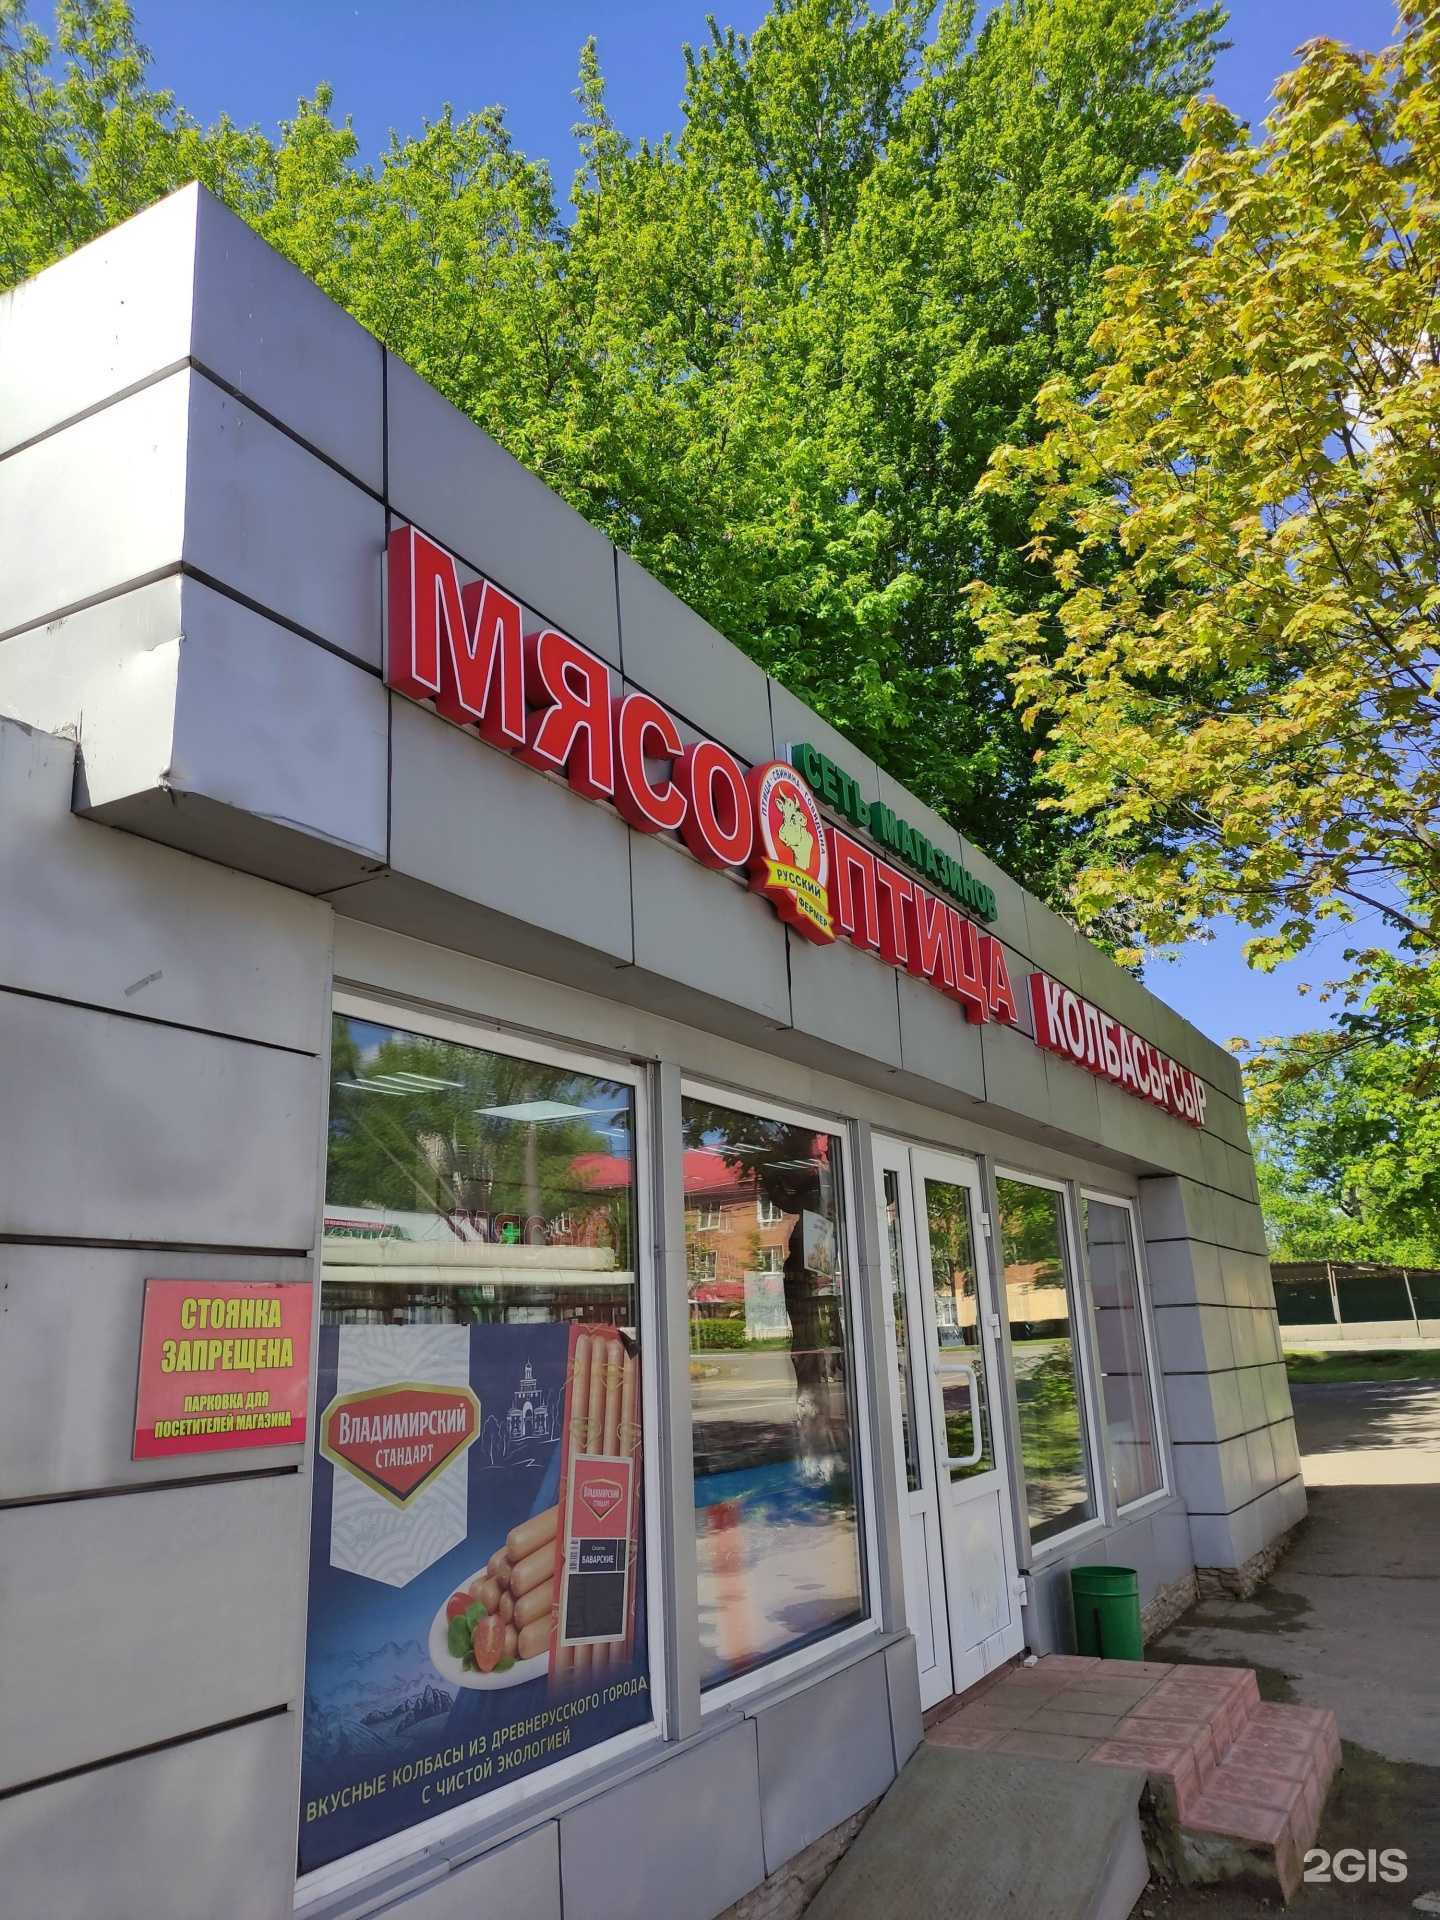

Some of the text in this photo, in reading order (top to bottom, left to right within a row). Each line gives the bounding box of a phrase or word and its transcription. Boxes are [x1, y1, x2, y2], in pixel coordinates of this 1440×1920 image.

[408, 525, 754, 867] МЯСО
[801, 743, 998, 922] СЕТЬ МАГАЗИНОВ
[798, 897, 829, 928] ФЕРМЕР
[833, 827, 1018, 1023] ПТИЦА
[181, 1297, 282, 1330] СТОЯНКА
[161, 1338, 294, 1374] ЗАПРЕЩЕНА
[184, 1391, 269, 1413] ПАРКОВКА ДЛЯ
[154, 1411, 292, 1439] ПОСЕТИТЕЛЕЙ МАГАЗИНА
[375, 1444, 434, 1468] СТАНДАРТ
[306, 1675, 648, 1823] ВКУСНЫЕ КОЛБАСЫ ИЗ ДРЕВНЕРУССКОГО ГОРОДА
[422, 1725, 571, 1804] С ЧИСТОЙ ЭКОЛОГИЕЙ
